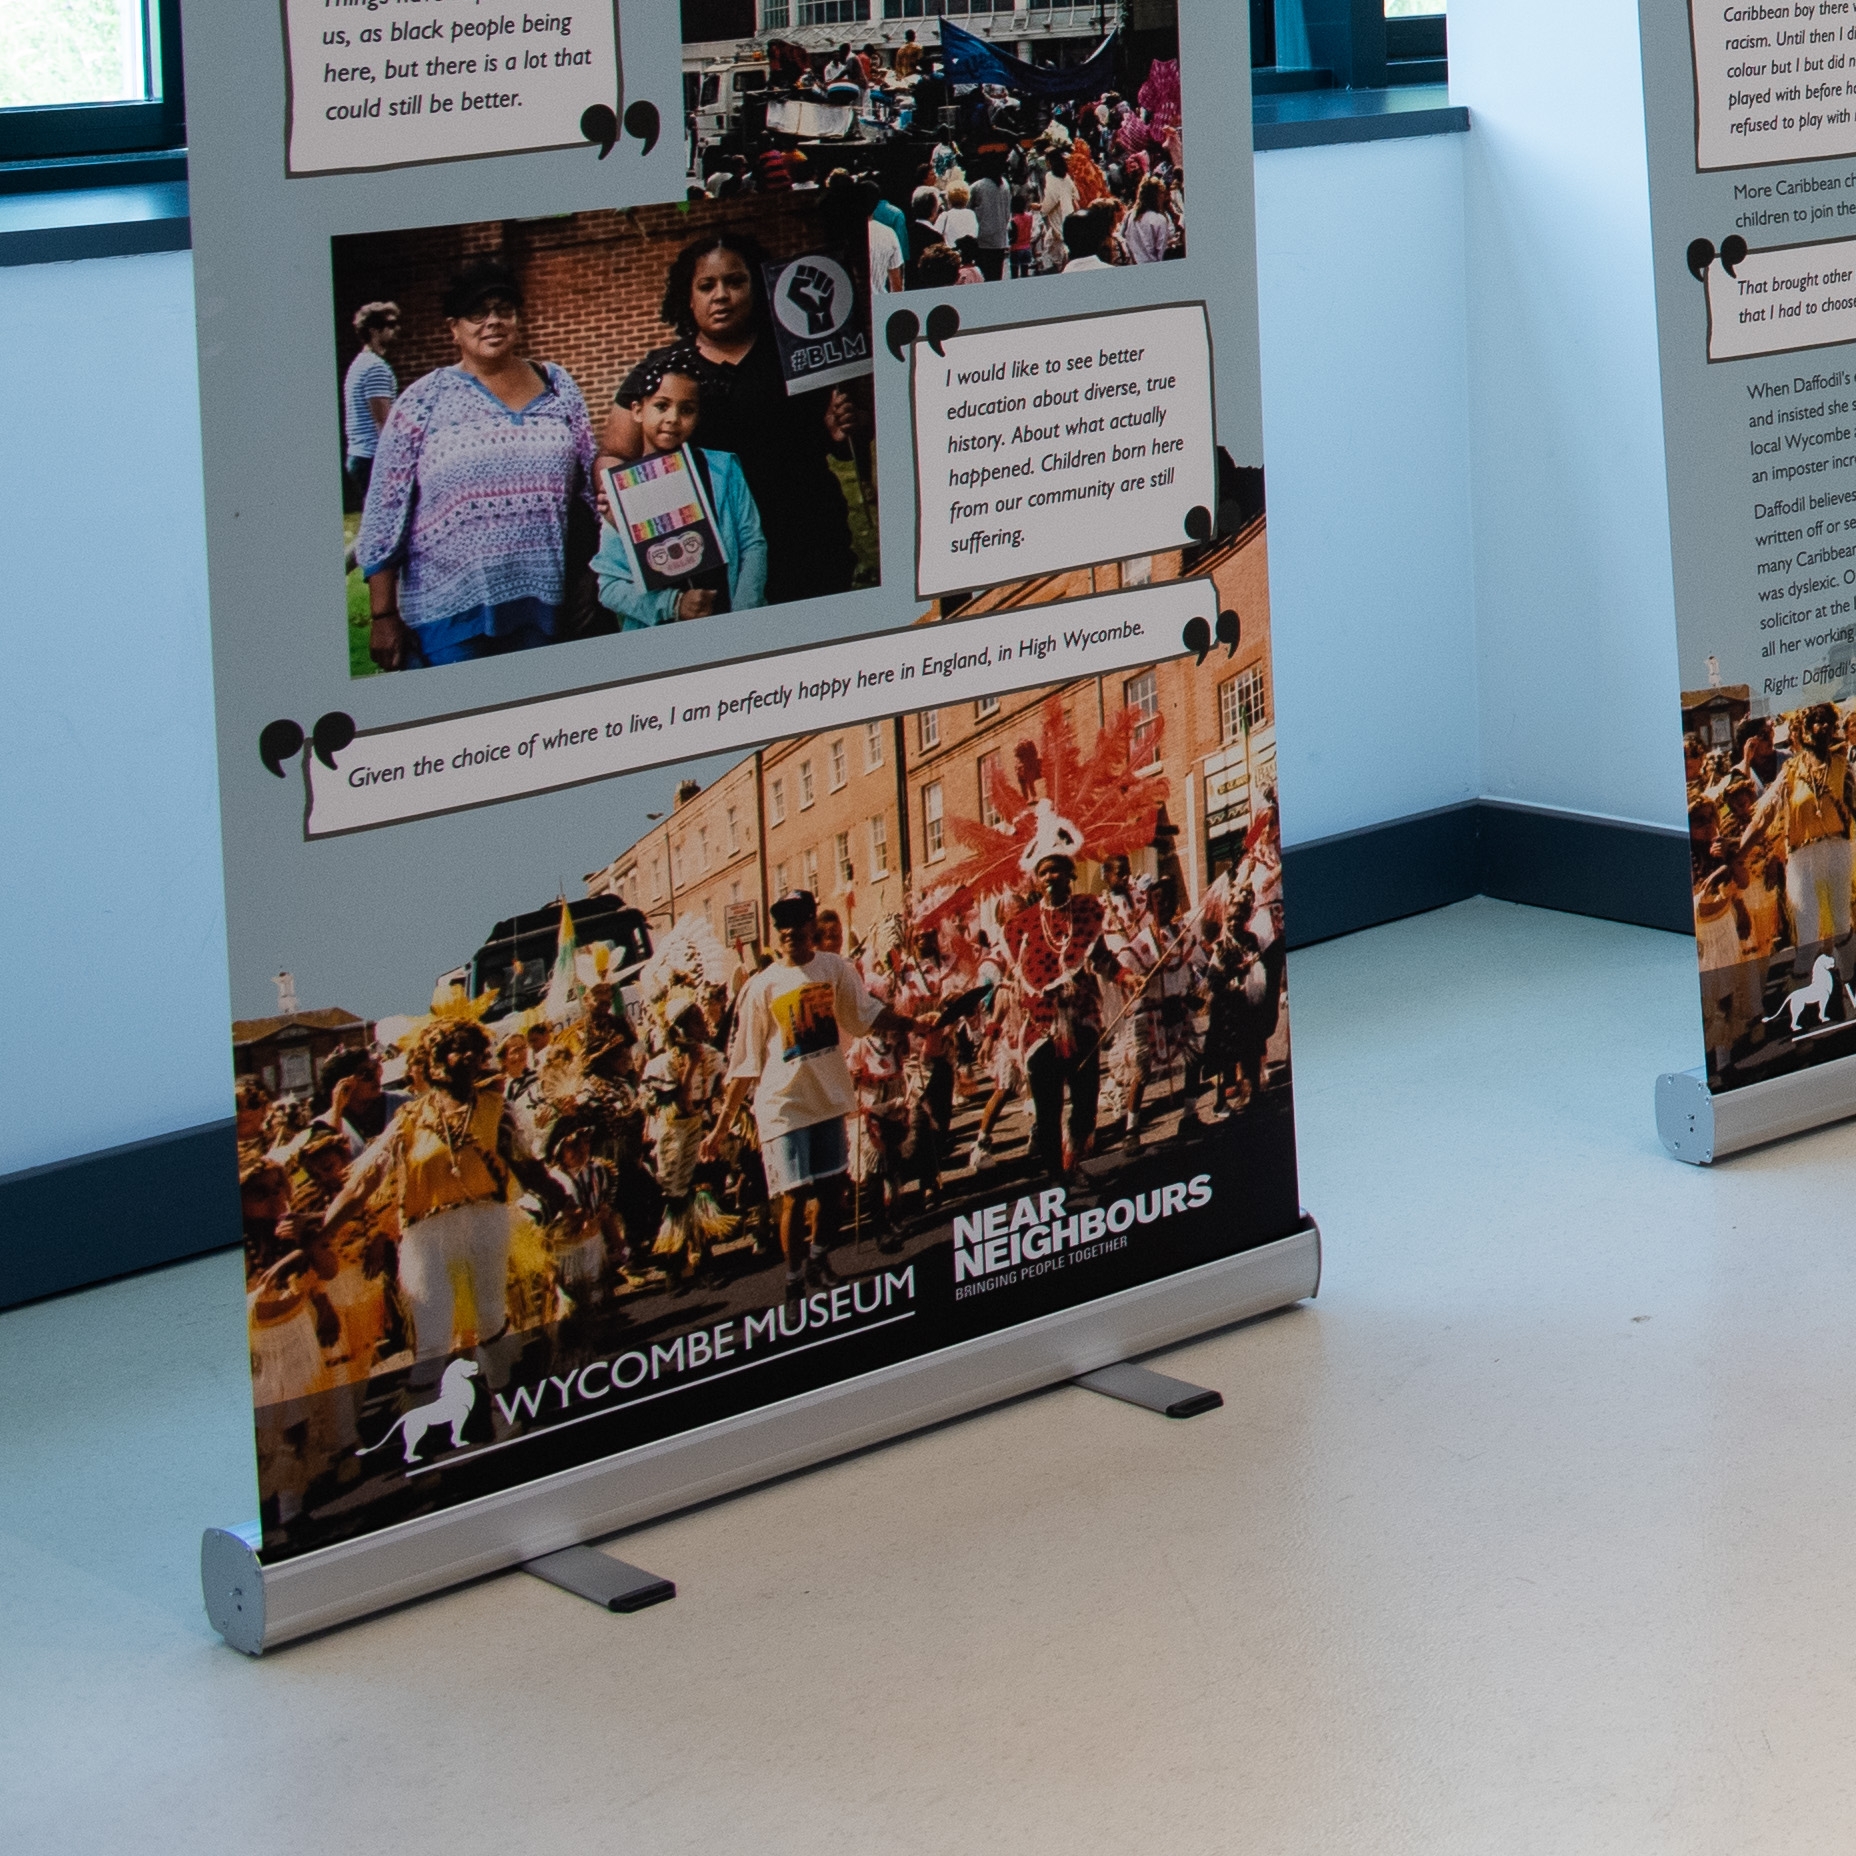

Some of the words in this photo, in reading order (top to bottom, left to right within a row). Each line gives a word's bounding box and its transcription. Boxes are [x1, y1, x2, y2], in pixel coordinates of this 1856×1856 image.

[790, 331, 867, 373] #BLM
[953, 1187, 1067, 1249] NEAR
[953, 1174, 1213, 1283] NEIGHBOURS
[955, 1270, 1017, 1301] BRINGING
[1020, 1255, 1065, 1281] PEOPLE
[1068, 1235, 1128, 1265] TOGETHER
[494, 1321, 735, 1426] WYCOMBE
[744, 1265, 915, 1350] MUSEUM
